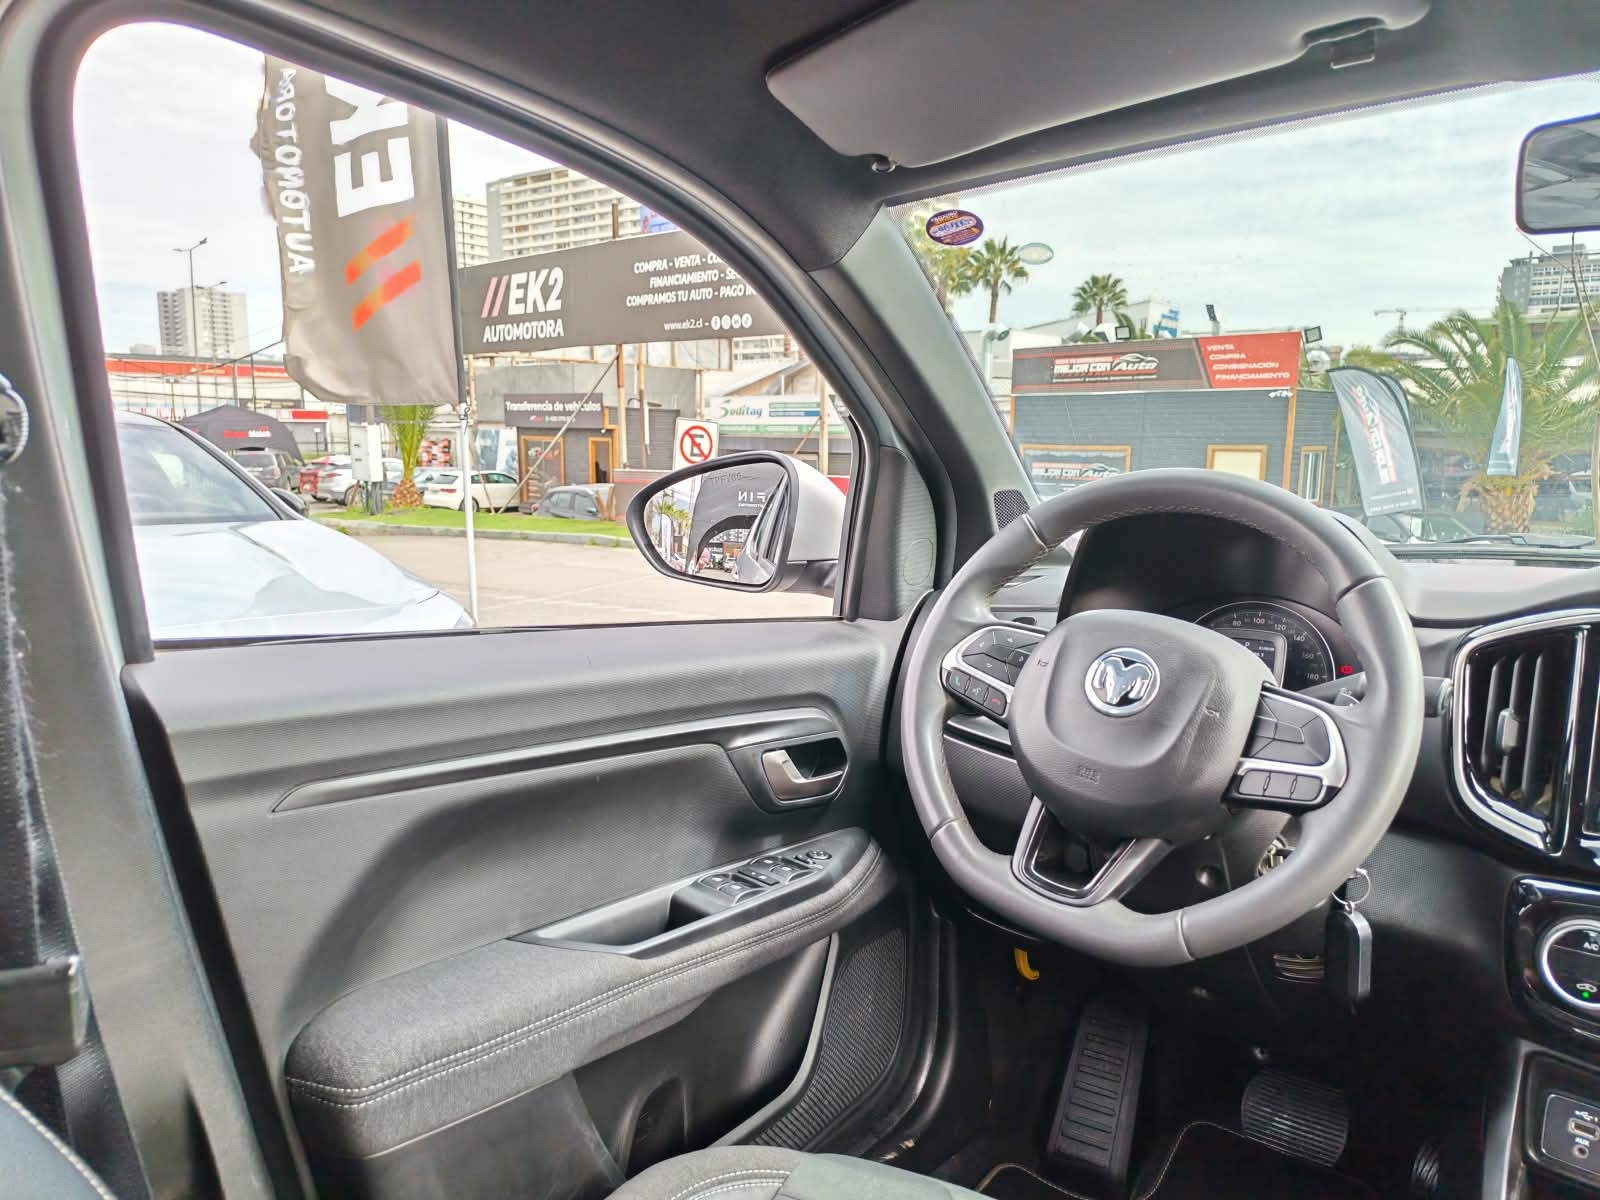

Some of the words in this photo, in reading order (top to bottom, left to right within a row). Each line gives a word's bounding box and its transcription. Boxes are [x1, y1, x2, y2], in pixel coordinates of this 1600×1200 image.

[634, 259, 668, 274] COMPRA
[674, 254, 702, 269] VENTA
[707, 252, 723, 265] CO
[649, 269, 719, 288] FINANCIAMIENTO
[725, 268, 741, 280] SE
[507, 266, 564, 316] EK2
[626, 291, 677, 307] COMPRAMOS
[677, 290, 689, 302] TU
[689, 287, 713, 301] AUTO
[719, 284, 744, 298] PAGO
[482, 318, 564, 343] AUTOMOTORA
[1206, 344, 1235, 352] VENTA
[1208, 353, 1247, 361] COMPRA
[505, 401, 553, 412] Transferencia
[553, 401, 564, 412] de
[1253, 617, 1266, 625] 100
